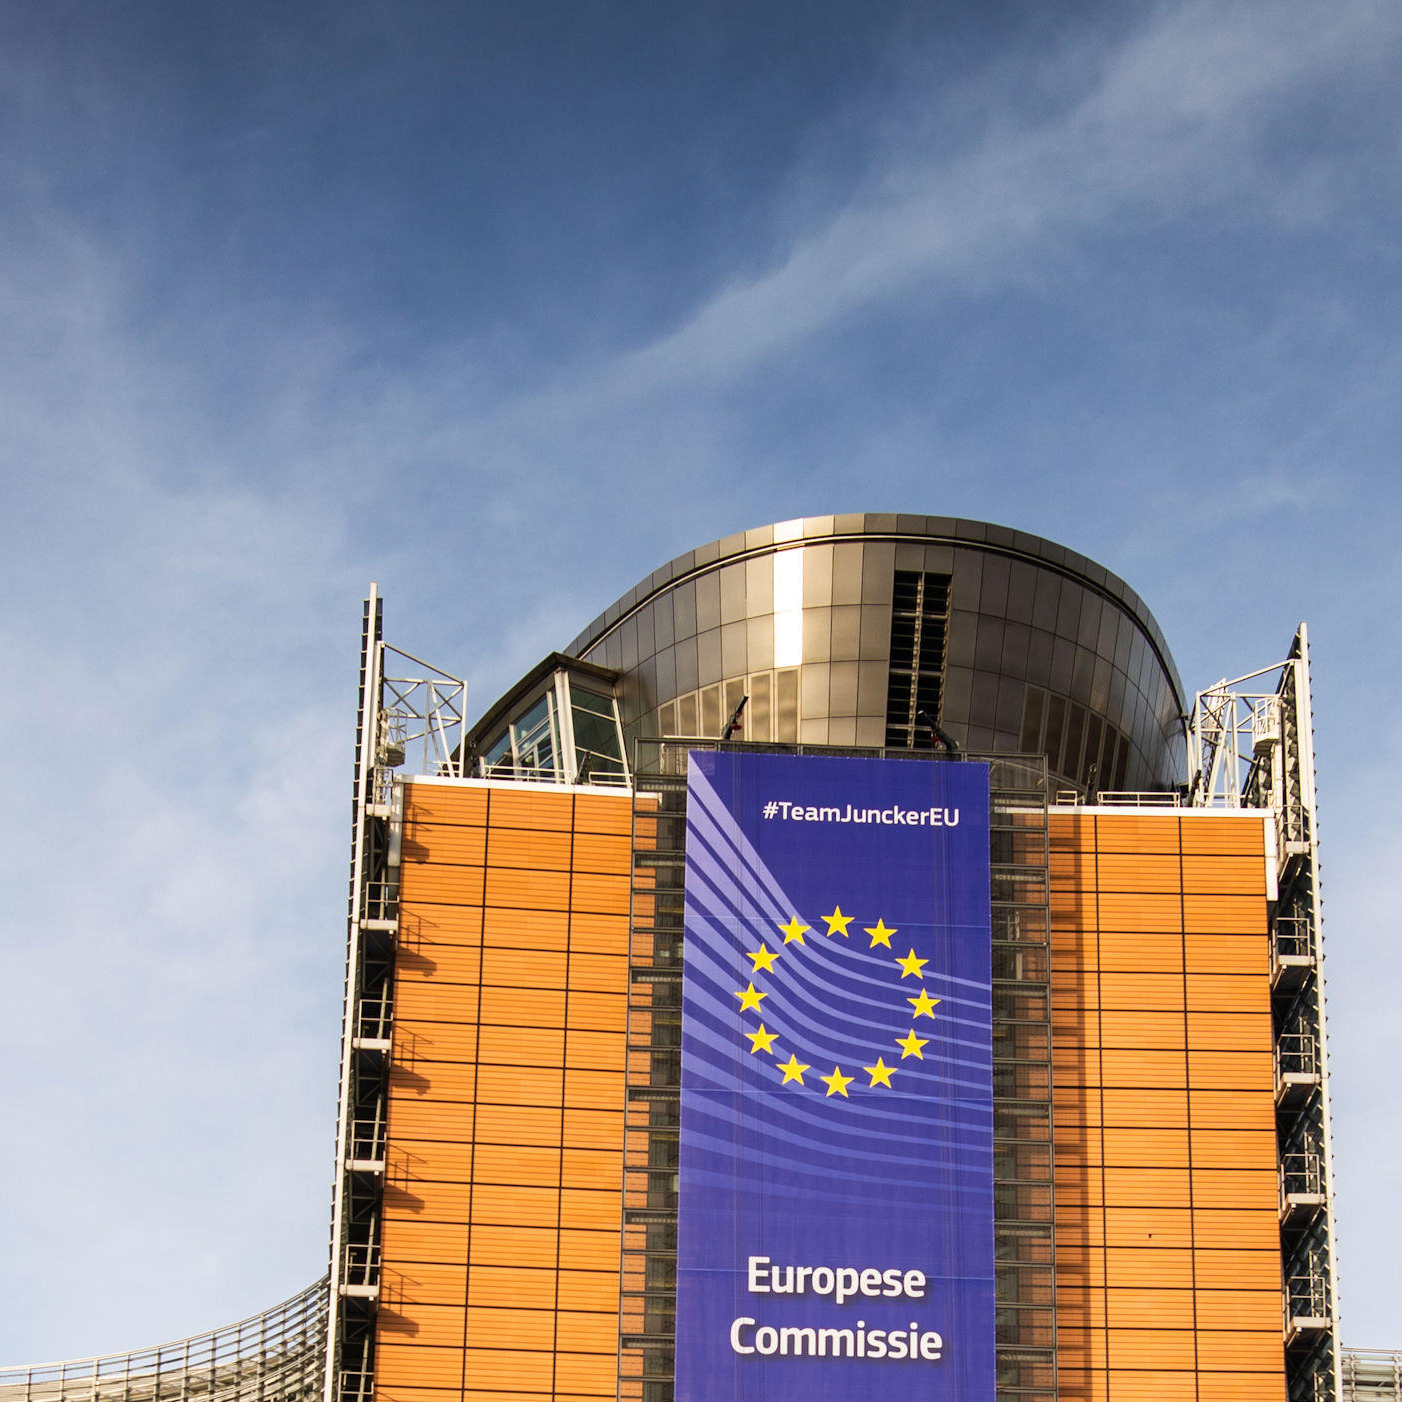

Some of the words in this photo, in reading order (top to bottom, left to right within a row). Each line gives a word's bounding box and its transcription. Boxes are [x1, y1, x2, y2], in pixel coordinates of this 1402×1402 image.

[762, 801, 959, 827] #TeamJunckerEU
[747, 1256, 927, 1304] Europese
[730, 1316, 943, 1361] Commissie
